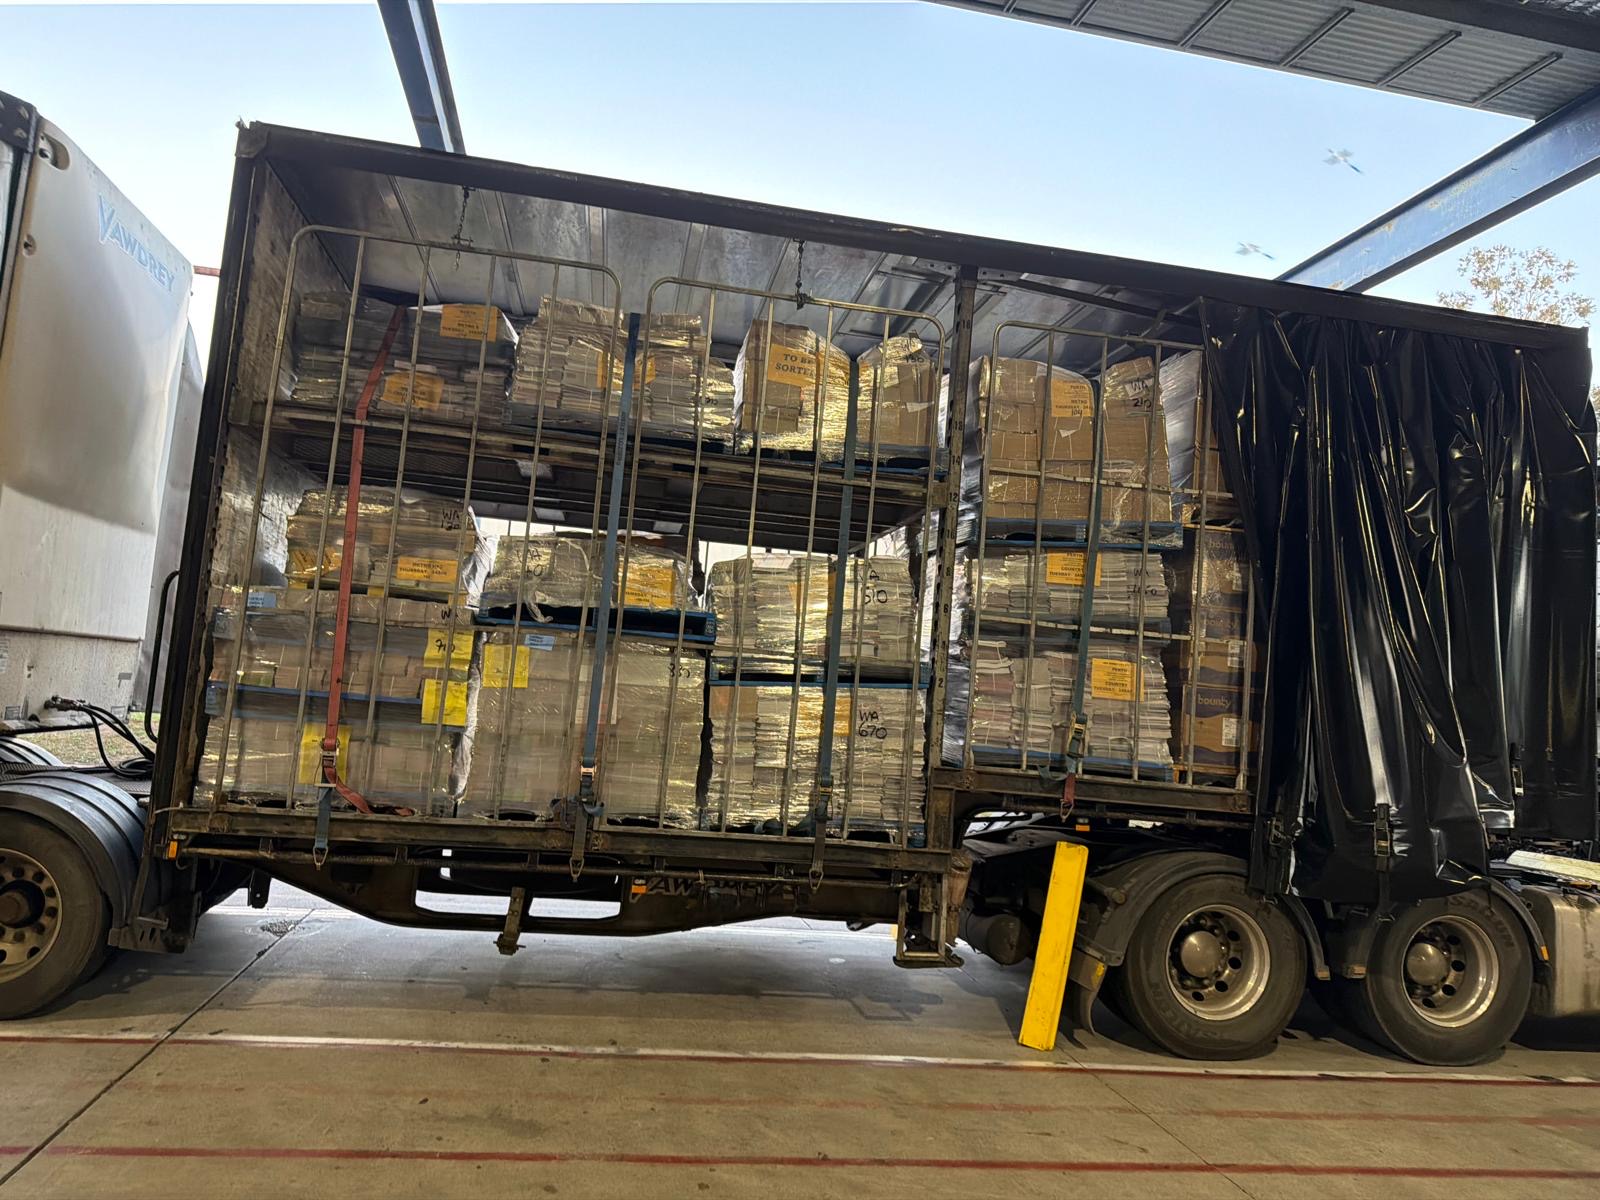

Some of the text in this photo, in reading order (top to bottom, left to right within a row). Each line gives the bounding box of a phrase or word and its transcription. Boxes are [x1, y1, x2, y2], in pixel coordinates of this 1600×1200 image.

[98, 193, 175, 292] VAWDREY
[783, 353, 798, 362] TO
[949, 492, 958, 503] 12
[938, 677, 944, 688] 2
[1197, 693, 1231, 710] bounty
[859, 709, 879, 721] WA
[858, 720, 888, 739] 670
